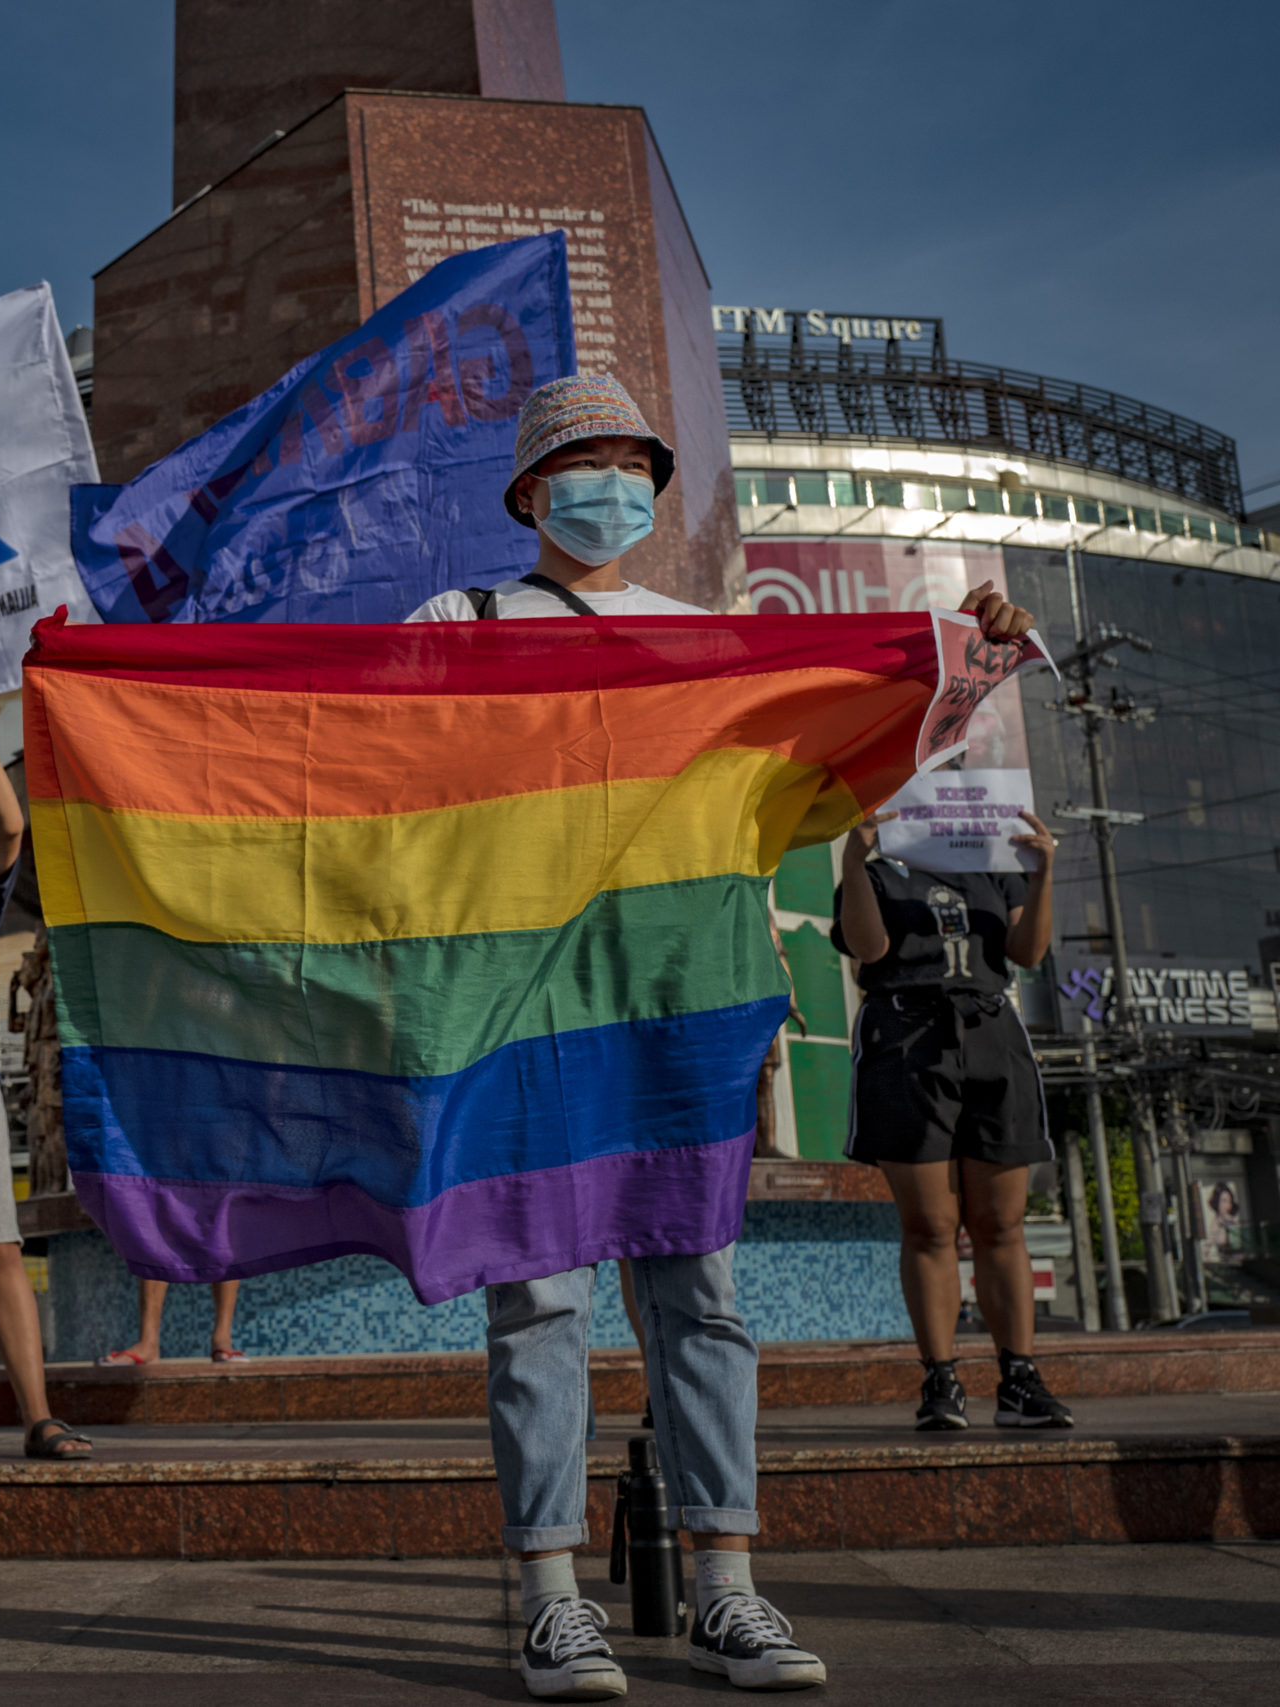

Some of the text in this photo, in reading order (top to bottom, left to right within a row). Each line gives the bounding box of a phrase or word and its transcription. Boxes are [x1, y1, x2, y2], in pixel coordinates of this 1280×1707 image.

[443, 201, 504, 218] memorial
[508, 203, 520, 219] is
[525, 207, 534, 219] a
[539, 206, 586, 222] marker
[590, 209, 605, 223] to
[403, 215, 442, 232] honor
[445, 217, 462, 233] all
[464, 218, 499, 235] those
[501, 220, 541, 236] whose
[575, 227, 606, 240] were
[405, 234, 448, 252] nipped
[451, 237, 464, 250] in
[580, 244, 607, 256] task
[586, 294, 612, 308] and
[600, 314, 614, 326] to
[807, 308, 923, 345] Square
[577, 328, 616, 344] irtues
[935, 786, 988, 802] KEEP
[899, 804, 1025, 821] PEMBERTON
[929, 821, 1001, 837] IN JAIL
[1106, 998, 1251, 1025] TNESS
